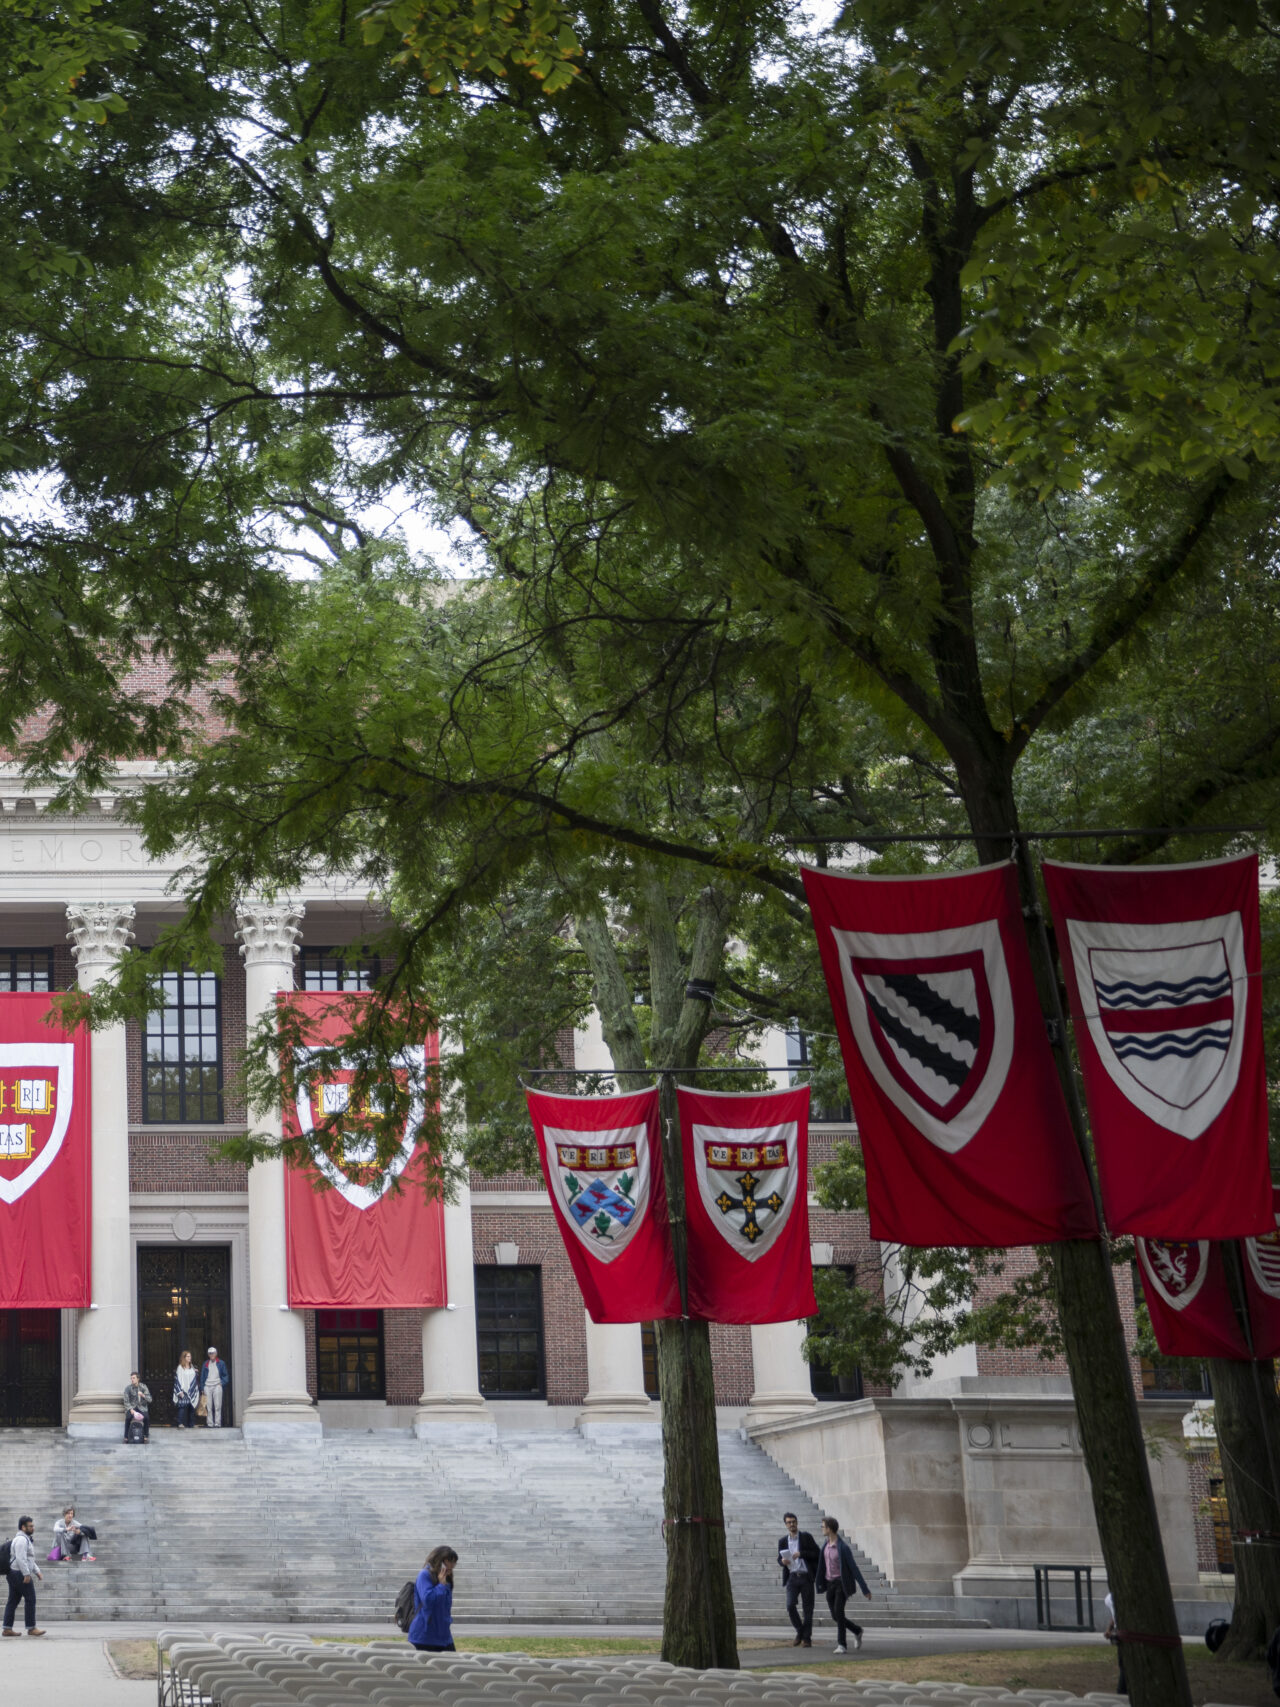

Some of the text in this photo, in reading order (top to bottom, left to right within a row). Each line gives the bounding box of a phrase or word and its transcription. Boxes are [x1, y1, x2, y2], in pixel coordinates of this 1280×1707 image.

[23, 1087, 40, 1102] RI
[561, 1150, 631, 1161] VE RI TAS
[713, 1149, 779, 1160] VE RI TAS
